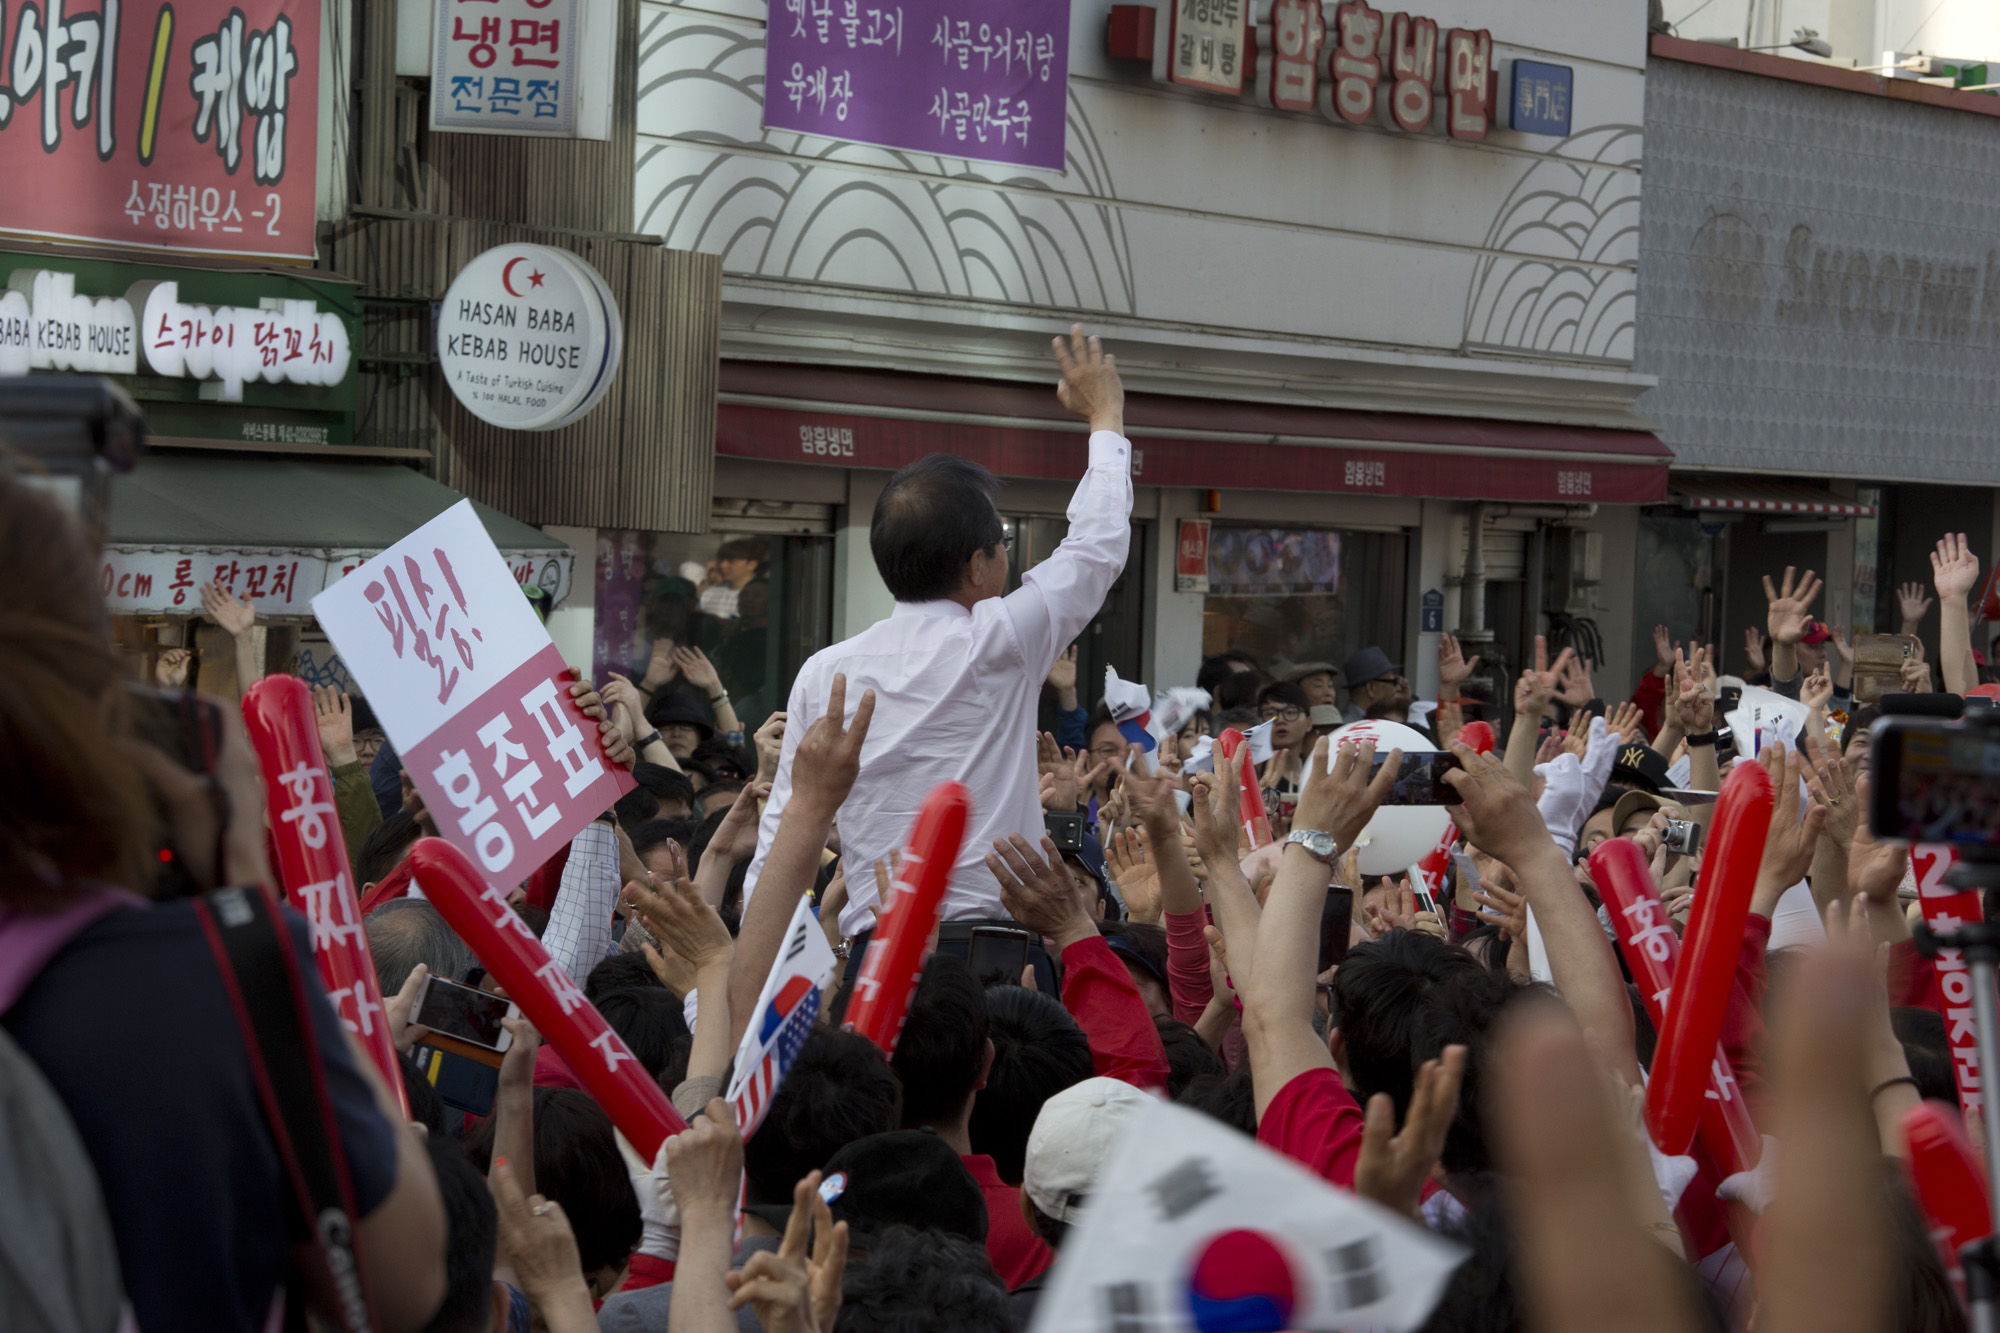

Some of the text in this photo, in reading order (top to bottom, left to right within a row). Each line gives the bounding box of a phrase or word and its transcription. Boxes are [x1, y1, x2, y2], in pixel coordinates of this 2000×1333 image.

[452, 16, 560, 69] 냉면
[931, 16, 1054, 82] 사골우거지탕
[1181, 33, 1236, 75] 갈비탕
[1272, 0, 1492, 140] 함흥냉면
[193, 14, 295, 179] 케밥
[451, 76, 559, 118] 전문점
[783, 62, 853, 121] 육개장
[928, 87, 1031, 148] 사골만두국
[38, 318, 81, 351] KEBAB
[88, 324, 131, 356] HOUSE
[459, 299, 576, 335] HASAN BABA
[154, 313, 333, 368] 스카이 닭꼬치
[448, 333, 581, 370] KEBAB HOUSE
[456, 370, 565, 395] A Taste of Turkish Cuisine
[498, 393, 522, 406] HALAL
[526, 396, 548, 408] FOOD
[799, 424, 855, 457] 함흥냉면
[1345, 460, 1385, 487] 함흥냉면
[168, 559, 195, 606] 롱
[1428, 610, 1436, 629] 6
[431, 677, 605, 873] 홍준표
[1620, 747, 1645, 769] NY
